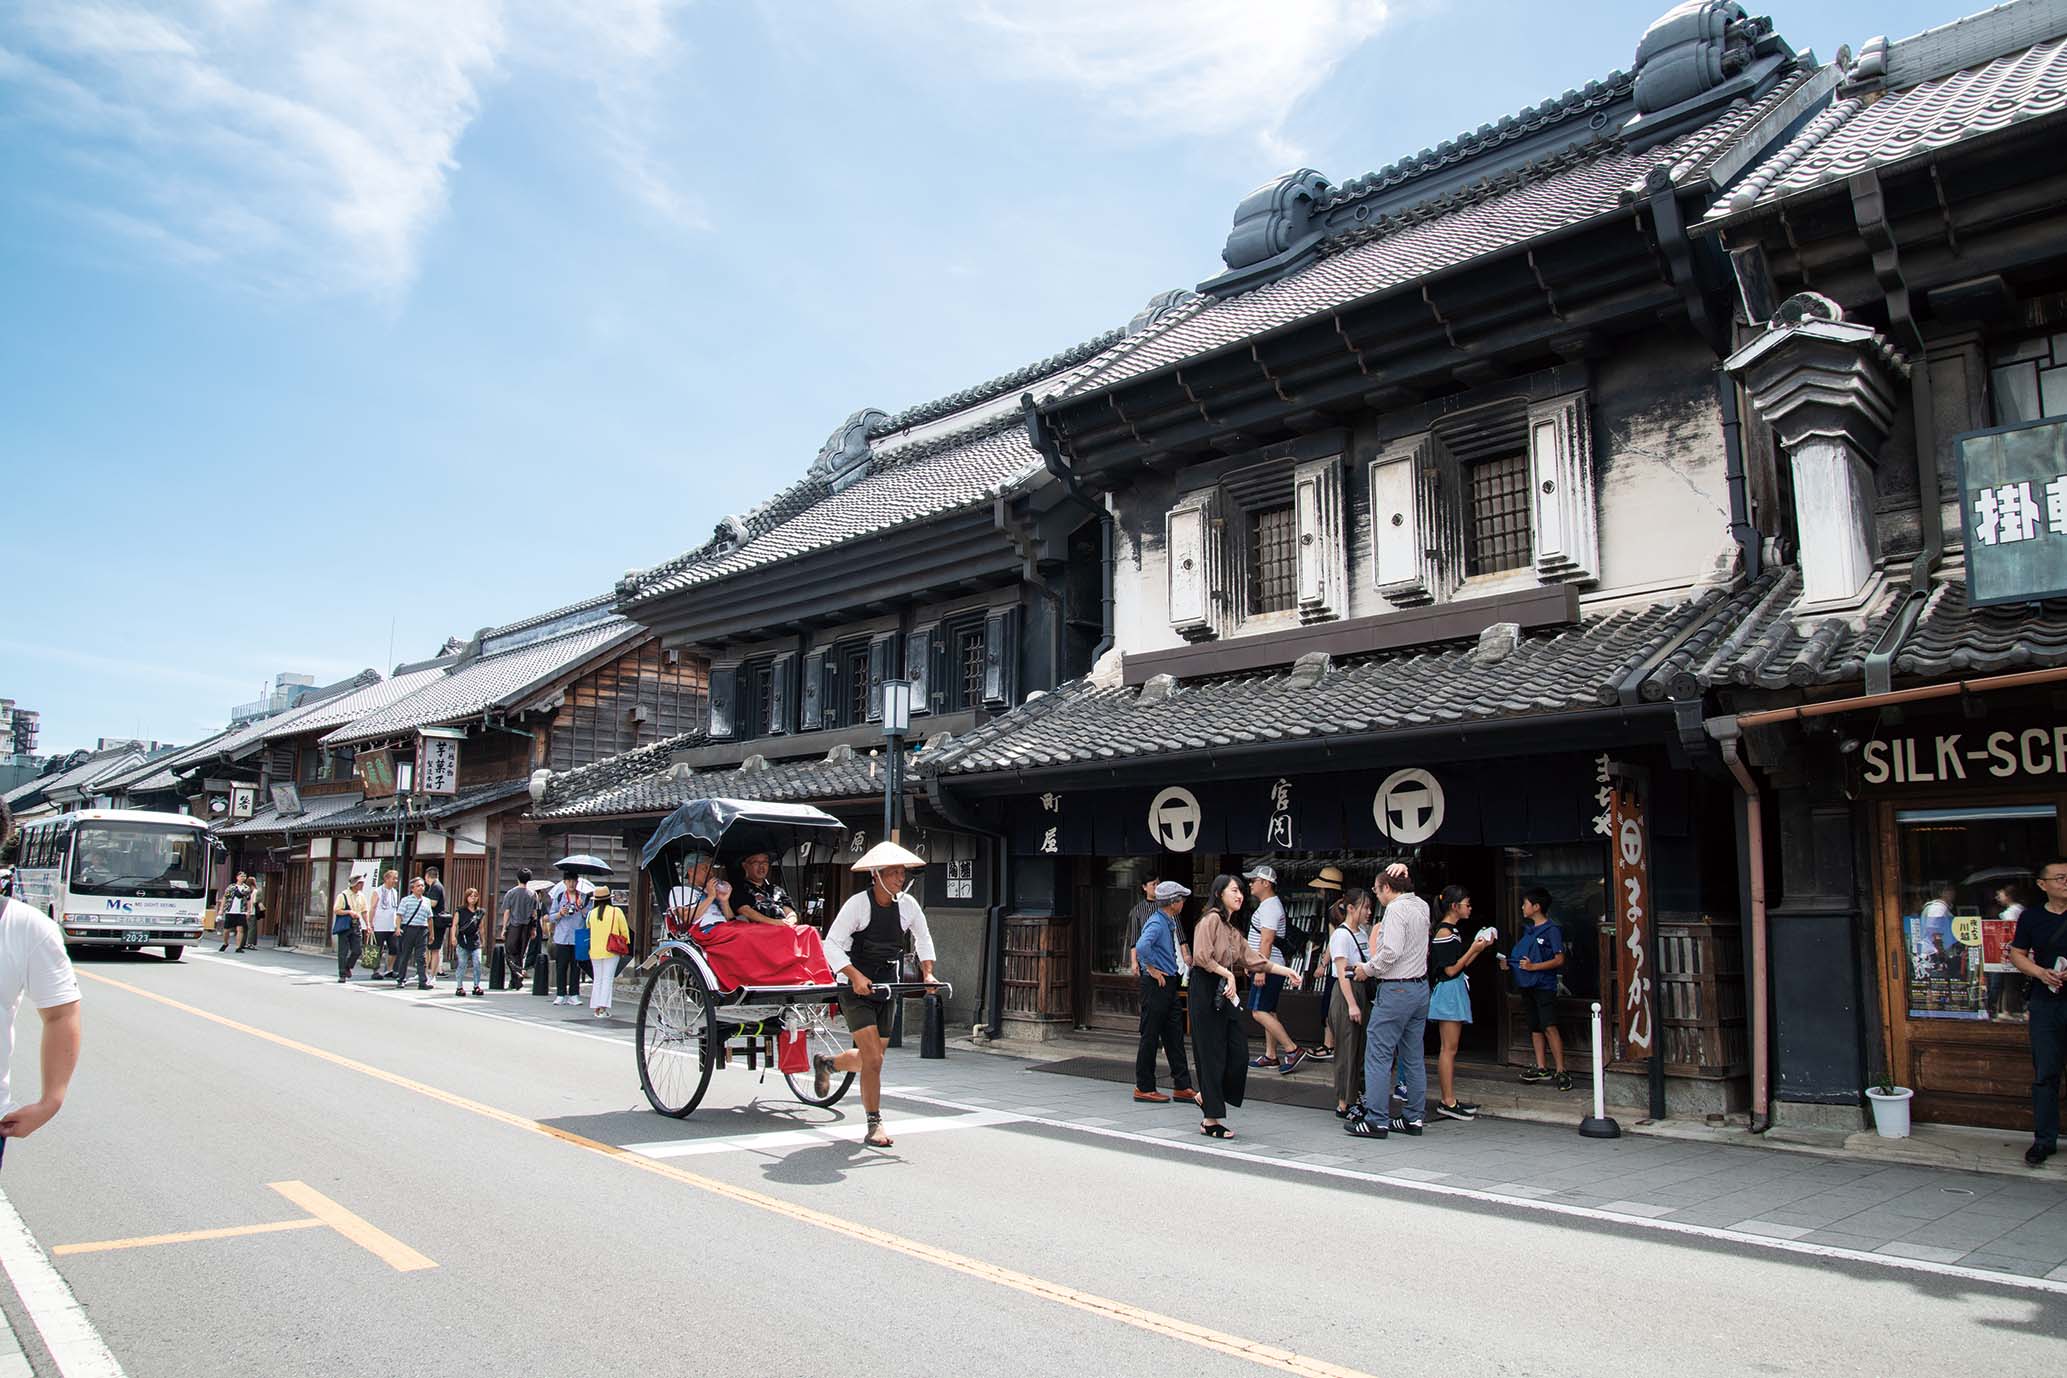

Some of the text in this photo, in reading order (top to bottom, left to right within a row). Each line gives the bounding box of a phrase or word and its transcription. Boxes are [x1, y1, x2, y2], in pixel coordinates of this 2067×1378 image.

[1974, 475, 2067, 546] 掛
[435, 741, 447, 790] 芋菓子
[850, 830, 866, 852] 原
[1624, 876, 1652, 1049] まちかん
